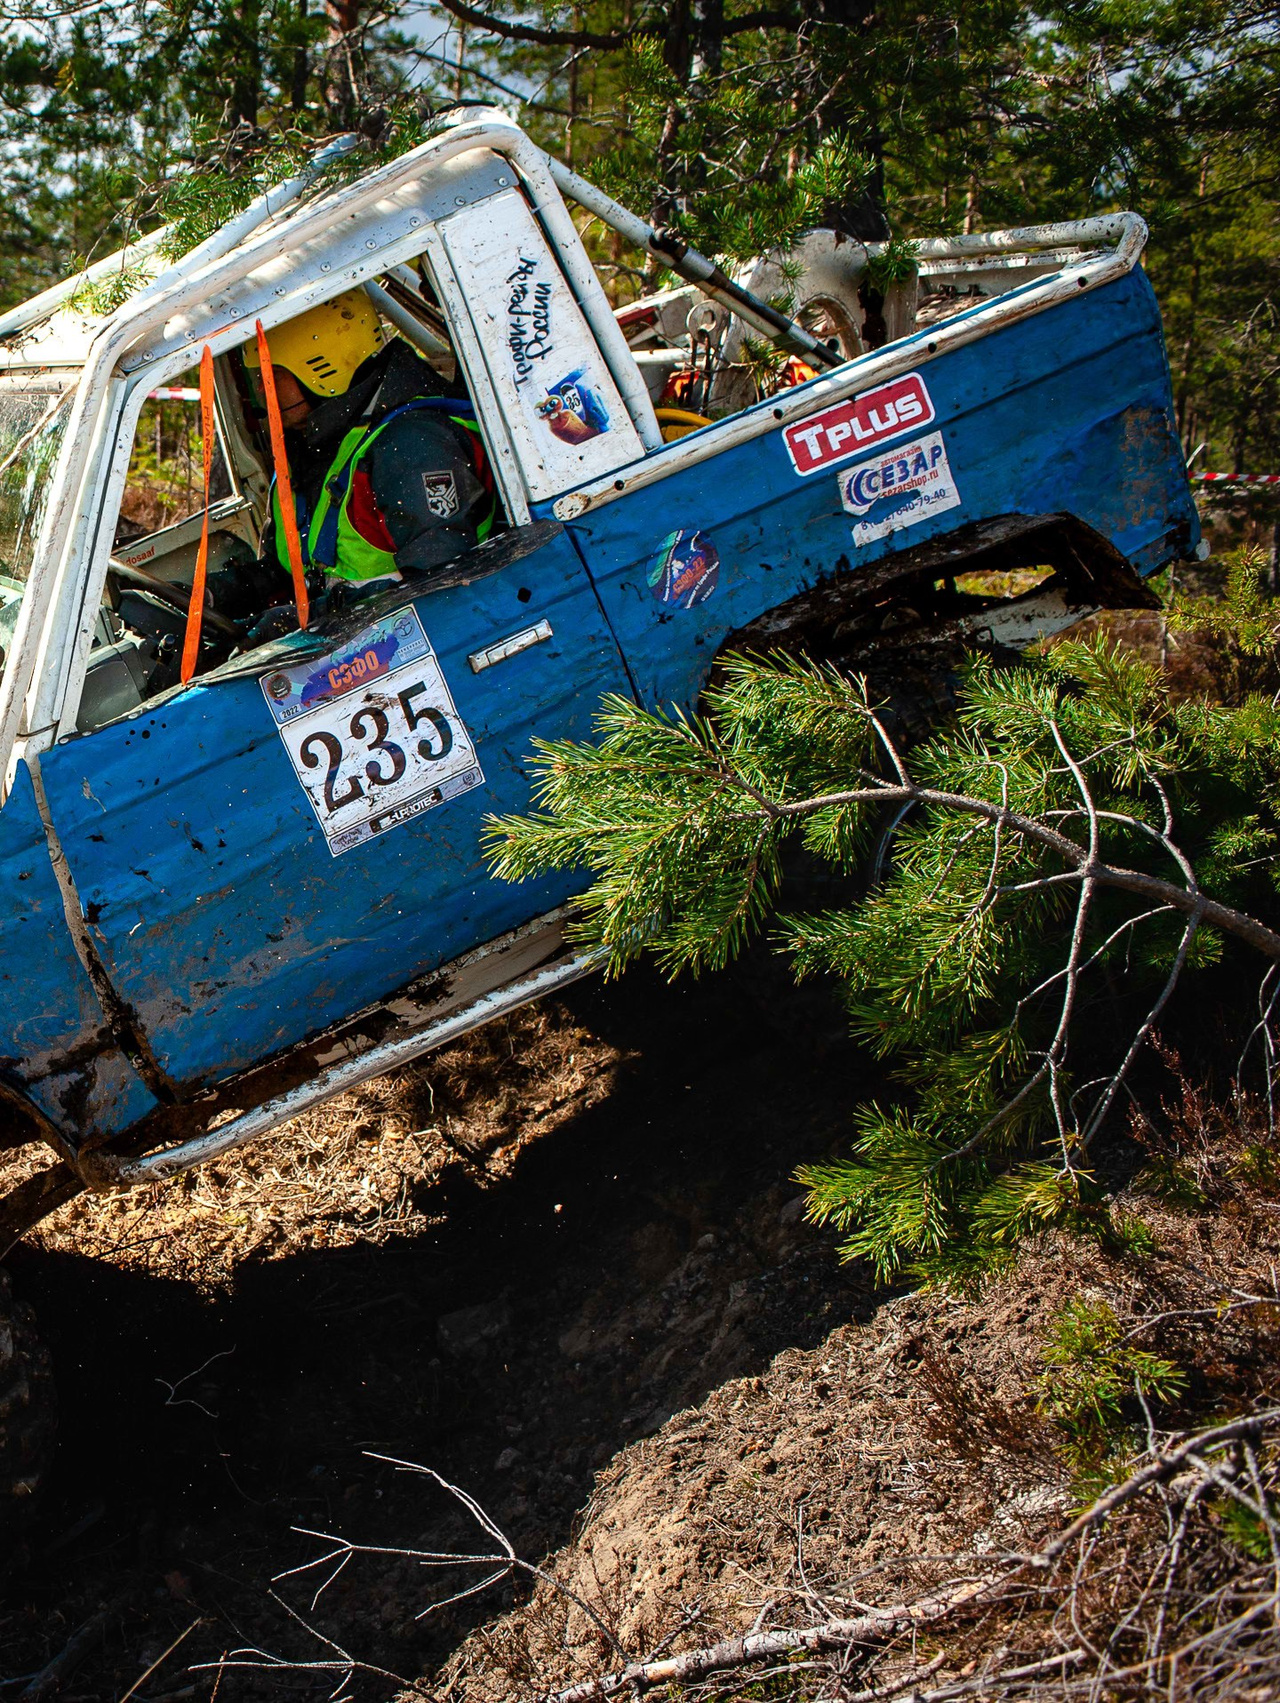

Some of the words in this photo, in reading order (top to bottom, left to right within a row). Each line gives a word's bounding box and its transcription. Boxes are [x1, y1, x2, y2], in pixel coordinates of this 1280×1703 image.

[505, 256, 538, 393] Трофи-рейды
[525, 281, 553, 361] России
[793, 392, 924, 460] TPLUS
[282, 705, 299, 719] 2022
[300, 681, 453, 812] 235
